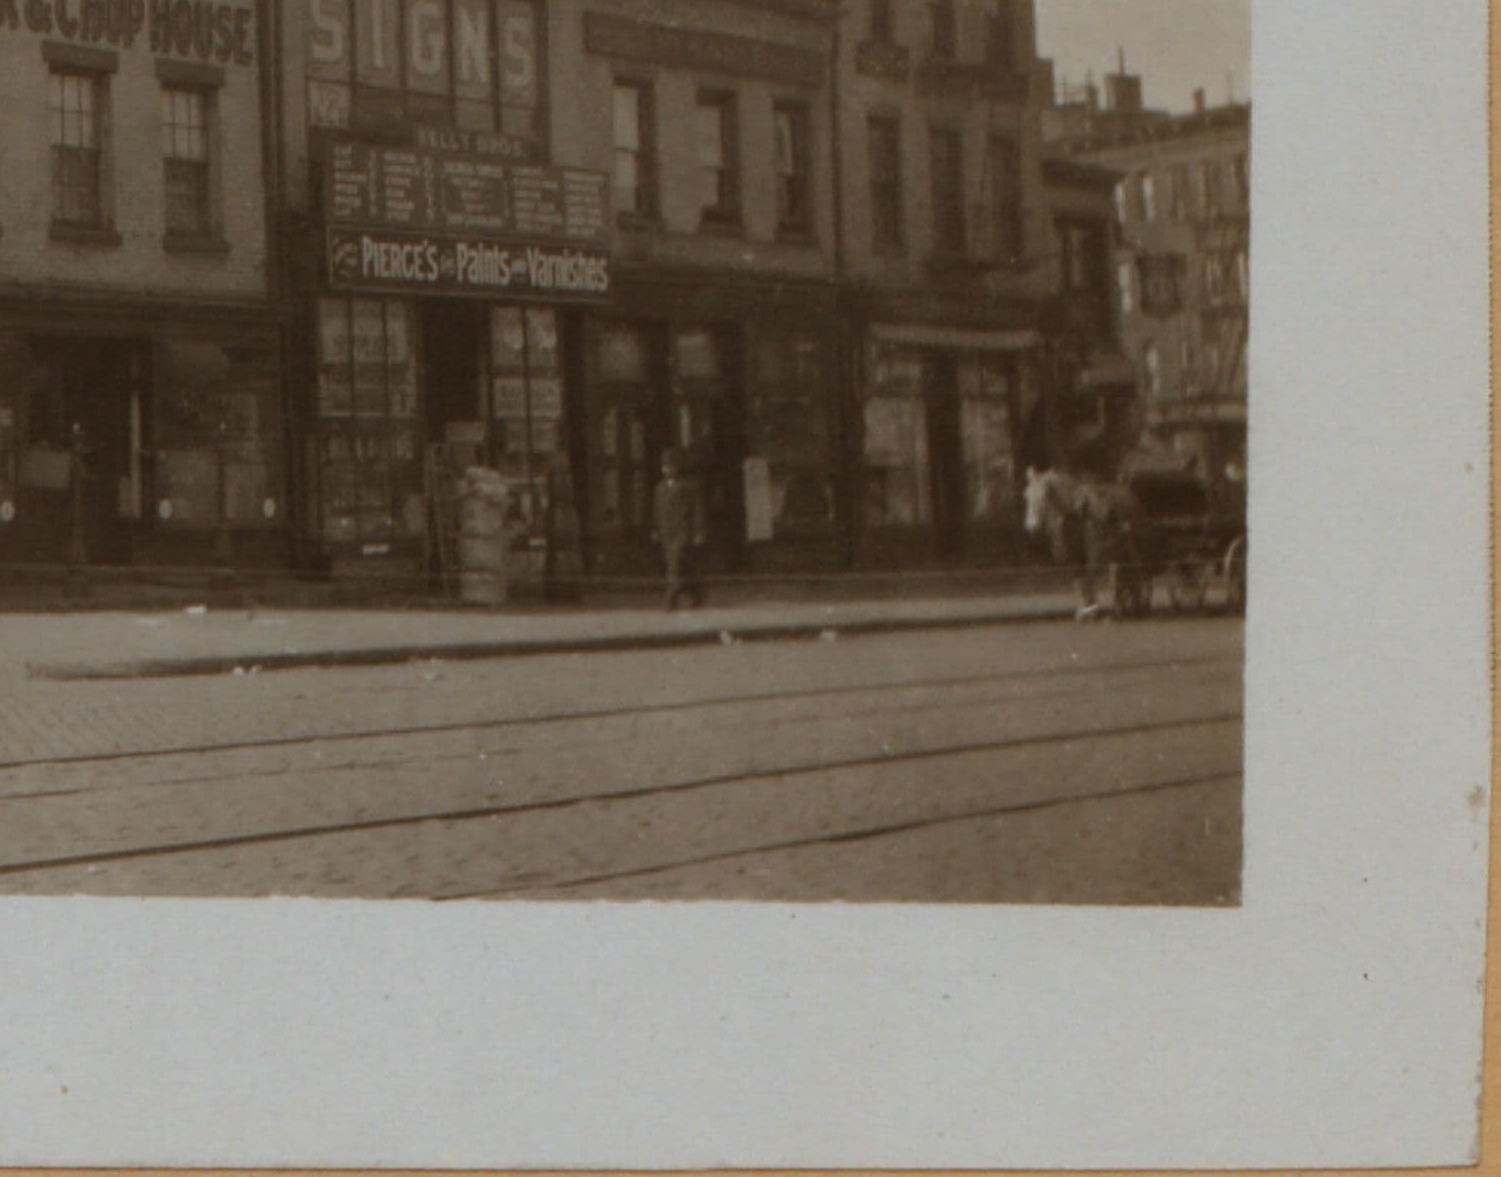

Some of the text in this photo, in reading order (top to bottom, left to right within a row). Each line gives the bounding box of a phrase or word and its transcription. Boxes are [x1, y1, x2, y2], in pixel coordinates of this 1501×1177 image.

[361, 234, 439, 283] PIERCE'S
[456, 242, 510, 287] Paints
[527, 246, 610, 294] Varnishes
